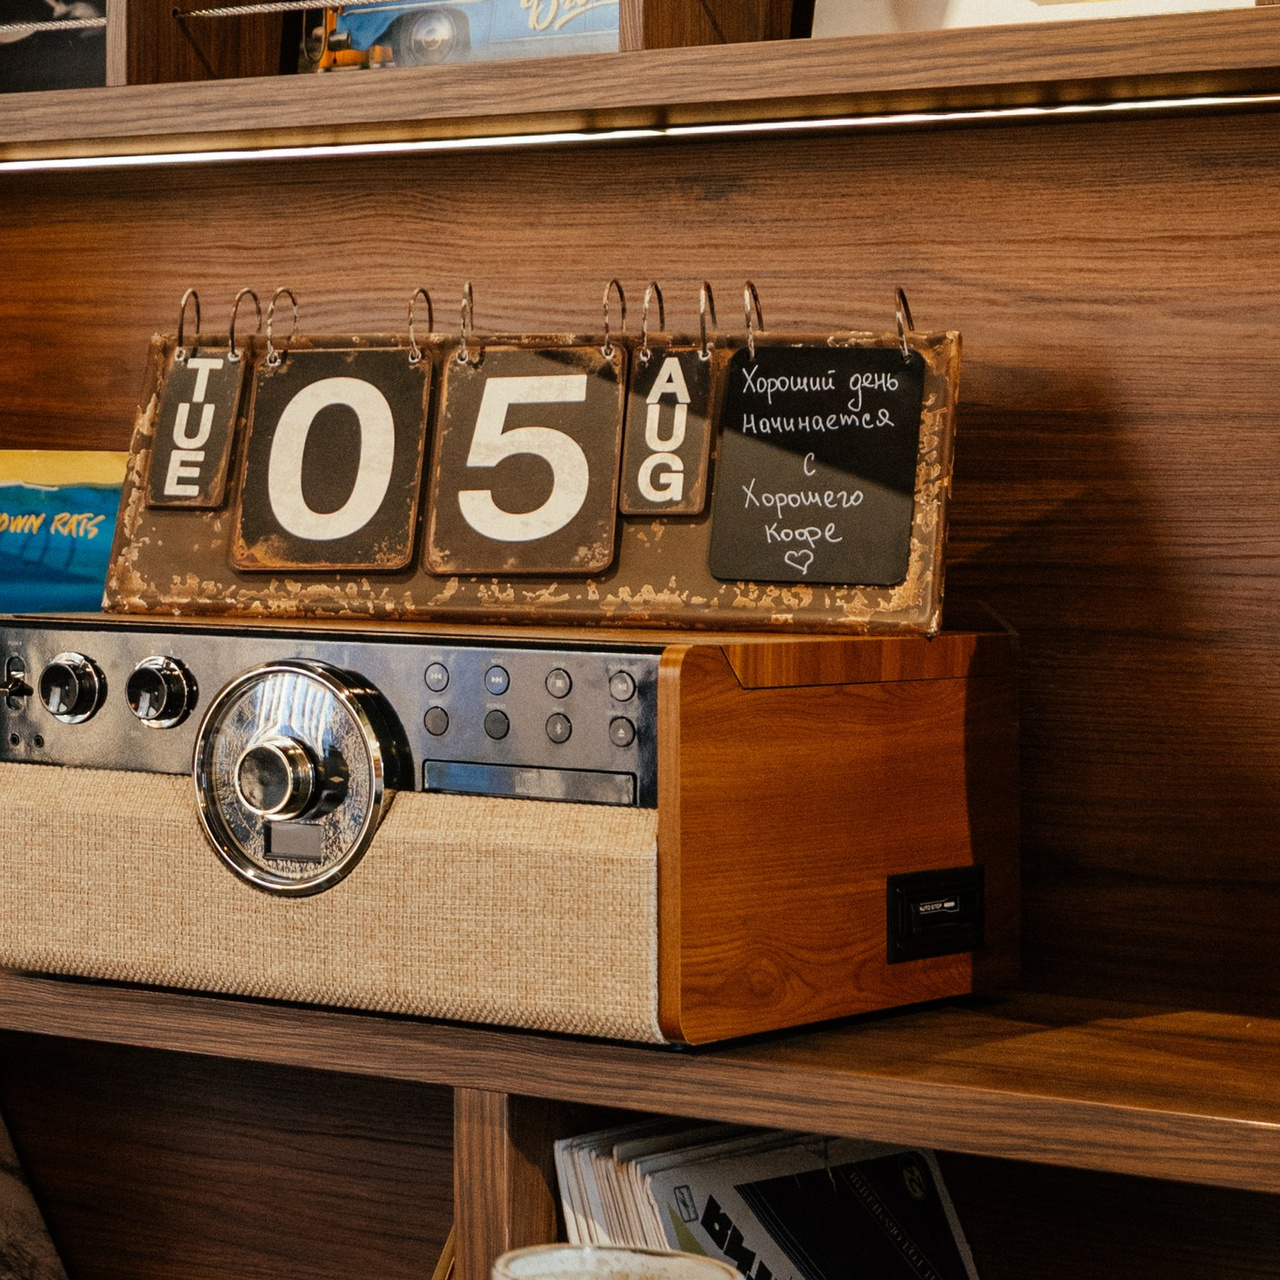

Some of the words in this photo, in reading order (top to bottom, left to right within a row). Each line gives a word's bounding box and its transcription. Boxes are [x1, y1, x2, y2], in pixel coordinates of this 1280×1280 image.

[742, 365, 835, 404] Хороший
[848, 372, 899, 412] день
[163, 357, 224, 496] TUE
[637, 356, 692, 503] AUG
[742, 478, 864, 519] Хорошего
[50, 512, 106, 539] RATS
